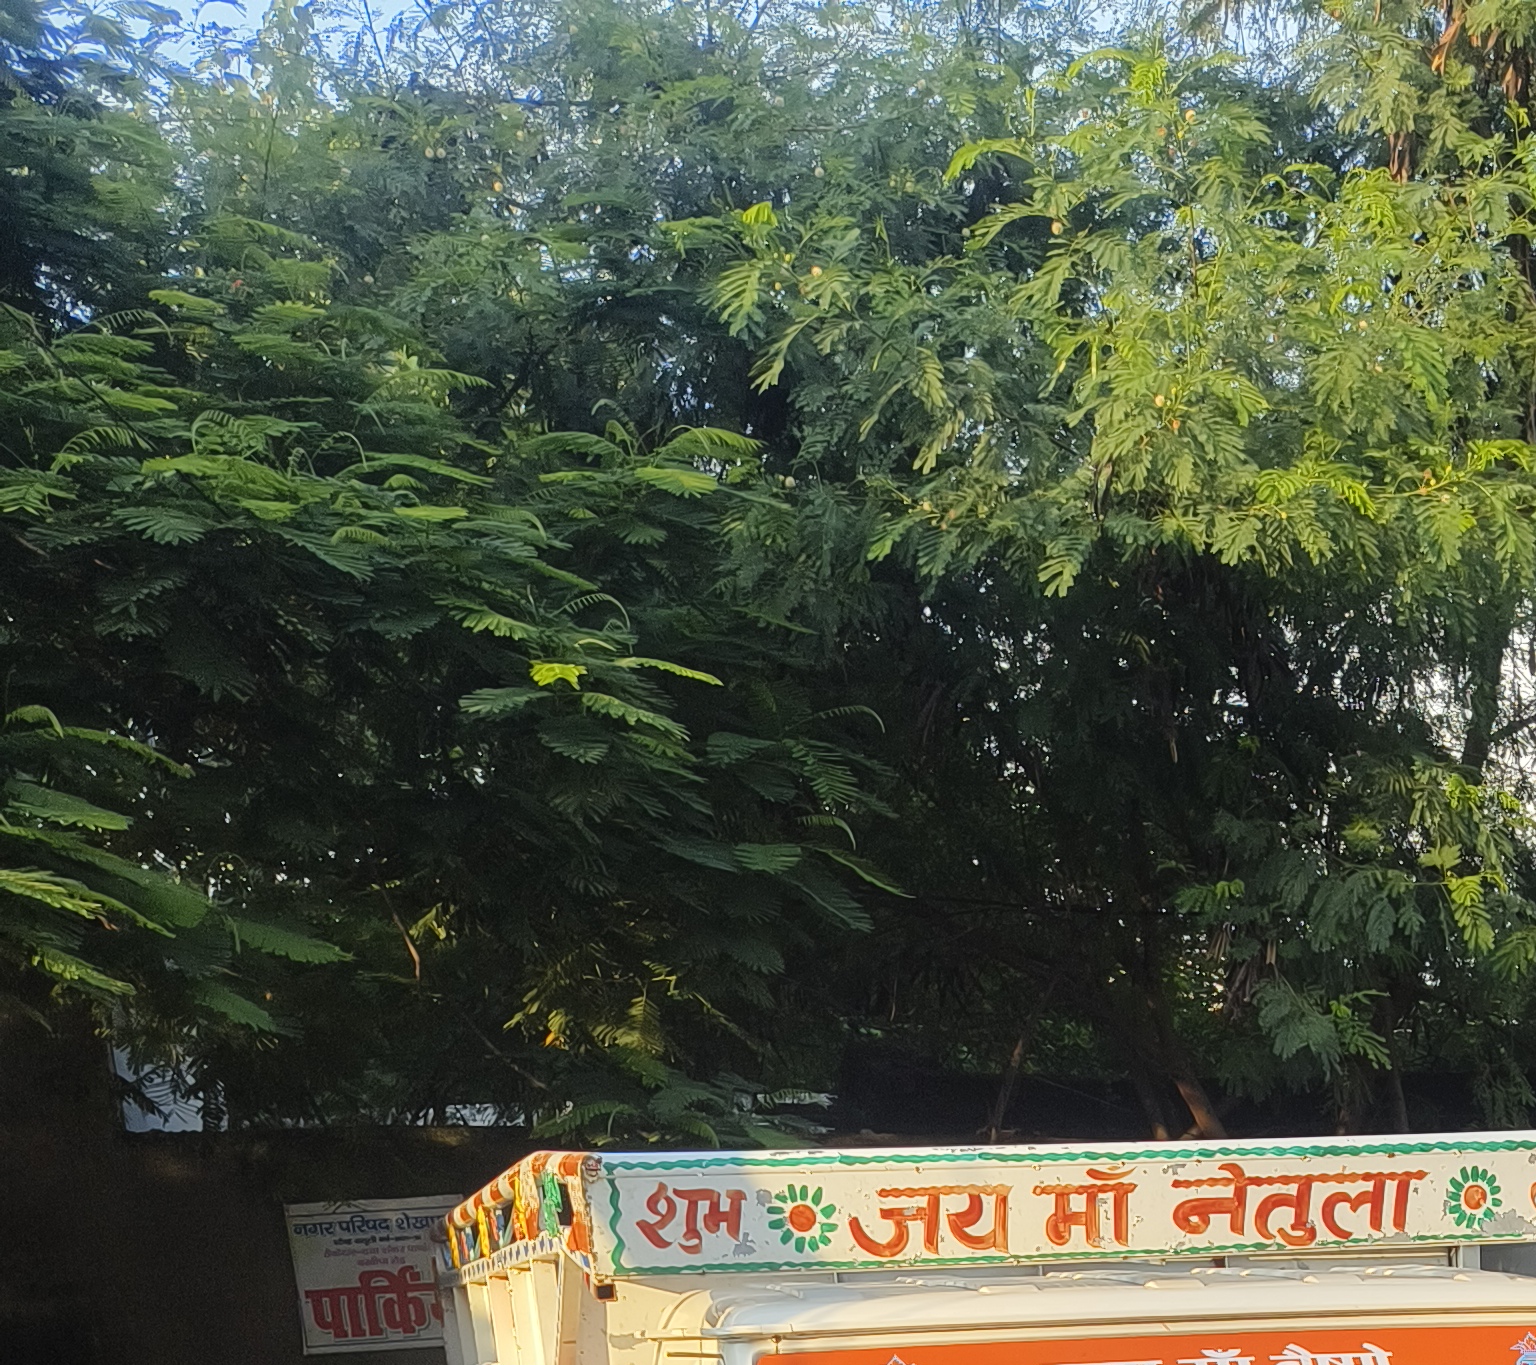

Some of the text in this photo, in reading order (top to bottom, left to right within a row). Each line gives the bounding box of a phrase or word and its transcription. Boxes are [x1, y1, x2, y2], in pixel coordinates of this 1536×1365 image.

[636, 1182, 747, 1255] शुभ
[848, 1185, 1014, 1258] जय
[1171, 1162, 1429, 1246] नेतुला
